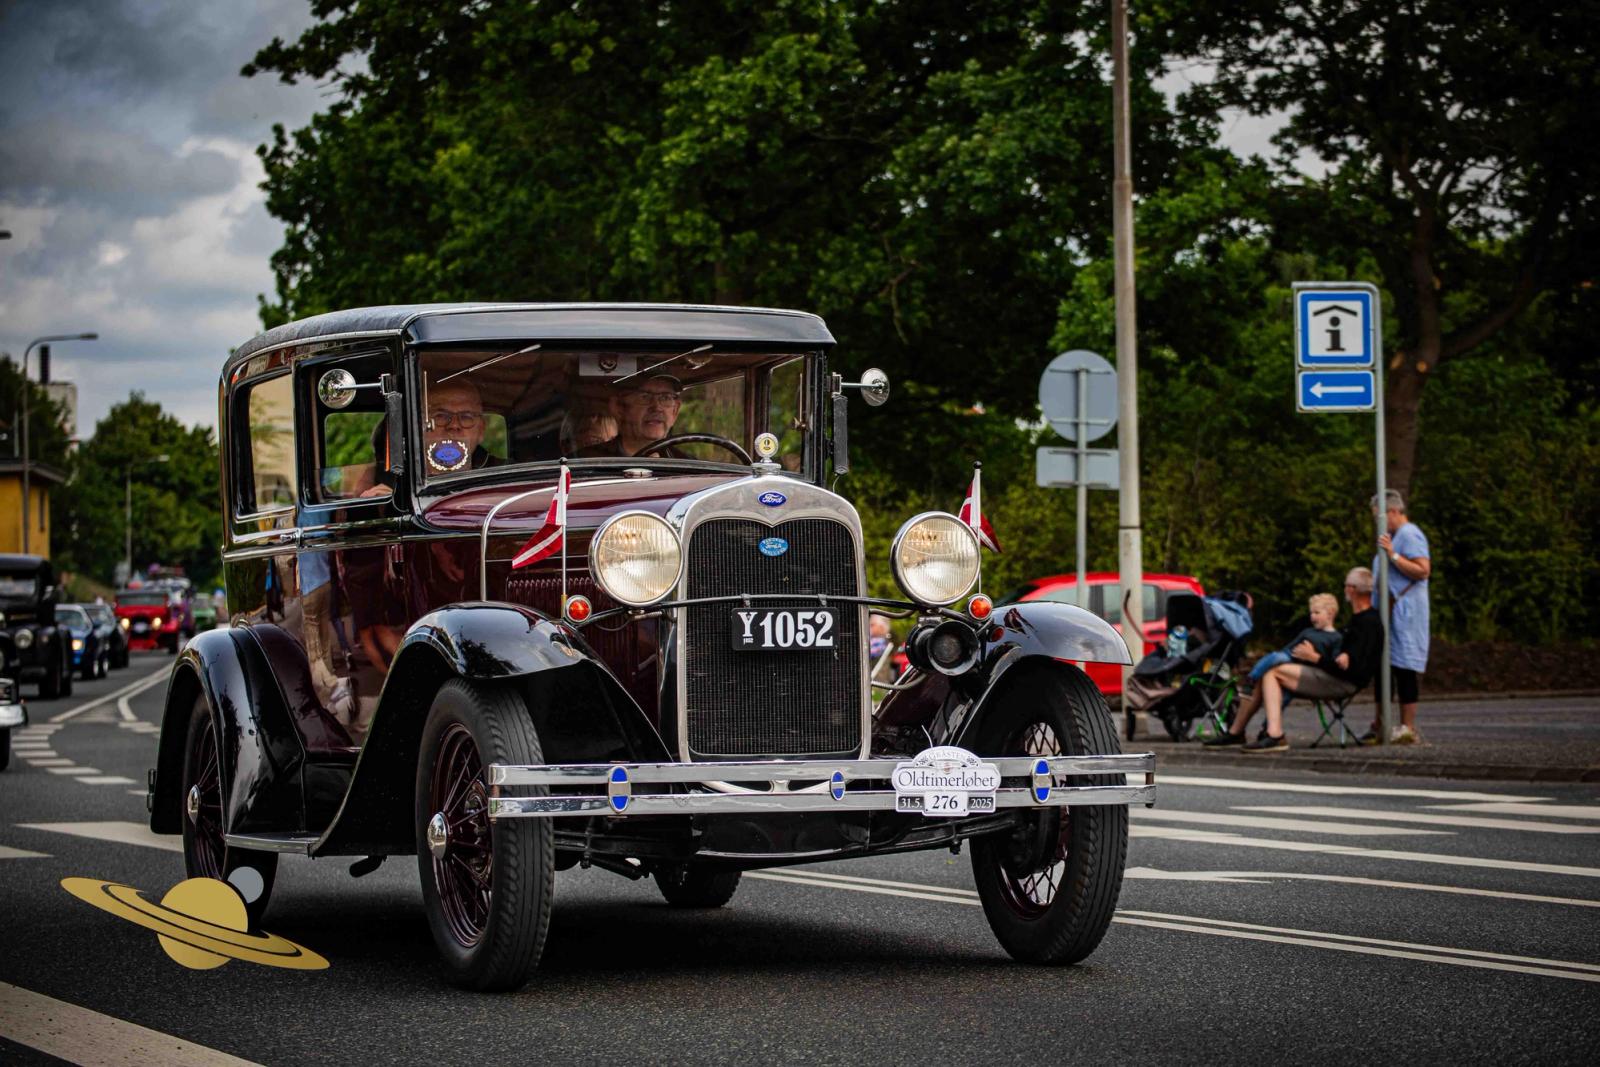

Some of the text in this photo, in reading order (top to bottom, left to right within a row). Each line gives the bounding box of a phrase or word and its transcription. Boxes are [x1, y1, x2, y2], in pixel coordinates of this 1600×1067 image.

[761, 493, 783, 503] Ford
[898, 770, 994, 788] Oldtimerløbet
[901, 795, 992, 809] 31.5. 276 2025
